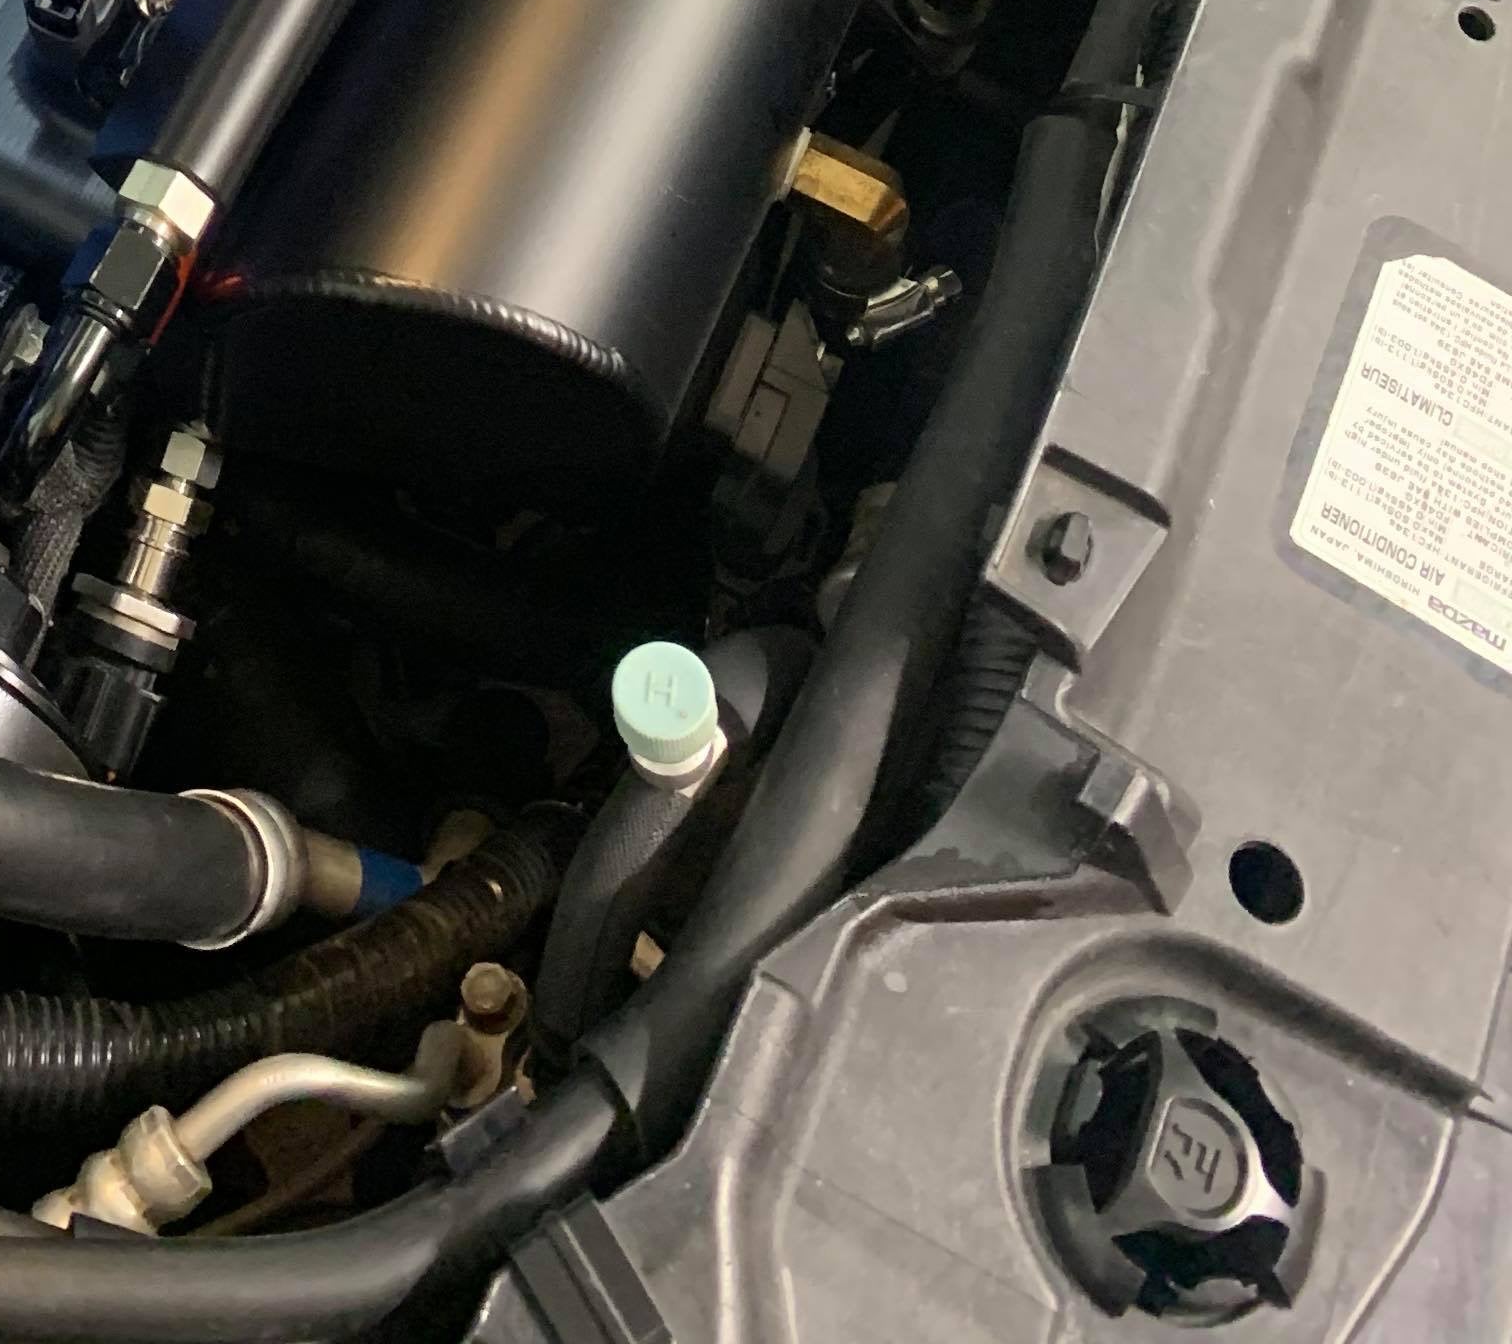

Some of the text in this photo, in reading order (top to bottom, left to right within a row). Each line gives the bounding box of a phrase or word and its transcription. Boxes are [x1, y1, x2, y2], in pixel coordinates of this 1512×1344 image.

[1358, 359, 1454, 429] CLIMATISEUR
[1308, 522, 1350, 554] JAPAN
[1318, 499, 1446, 588] AIR CONDITIONER
[1425, 592, 1508, 653] mazda
[644, 670, 680, 708] H
